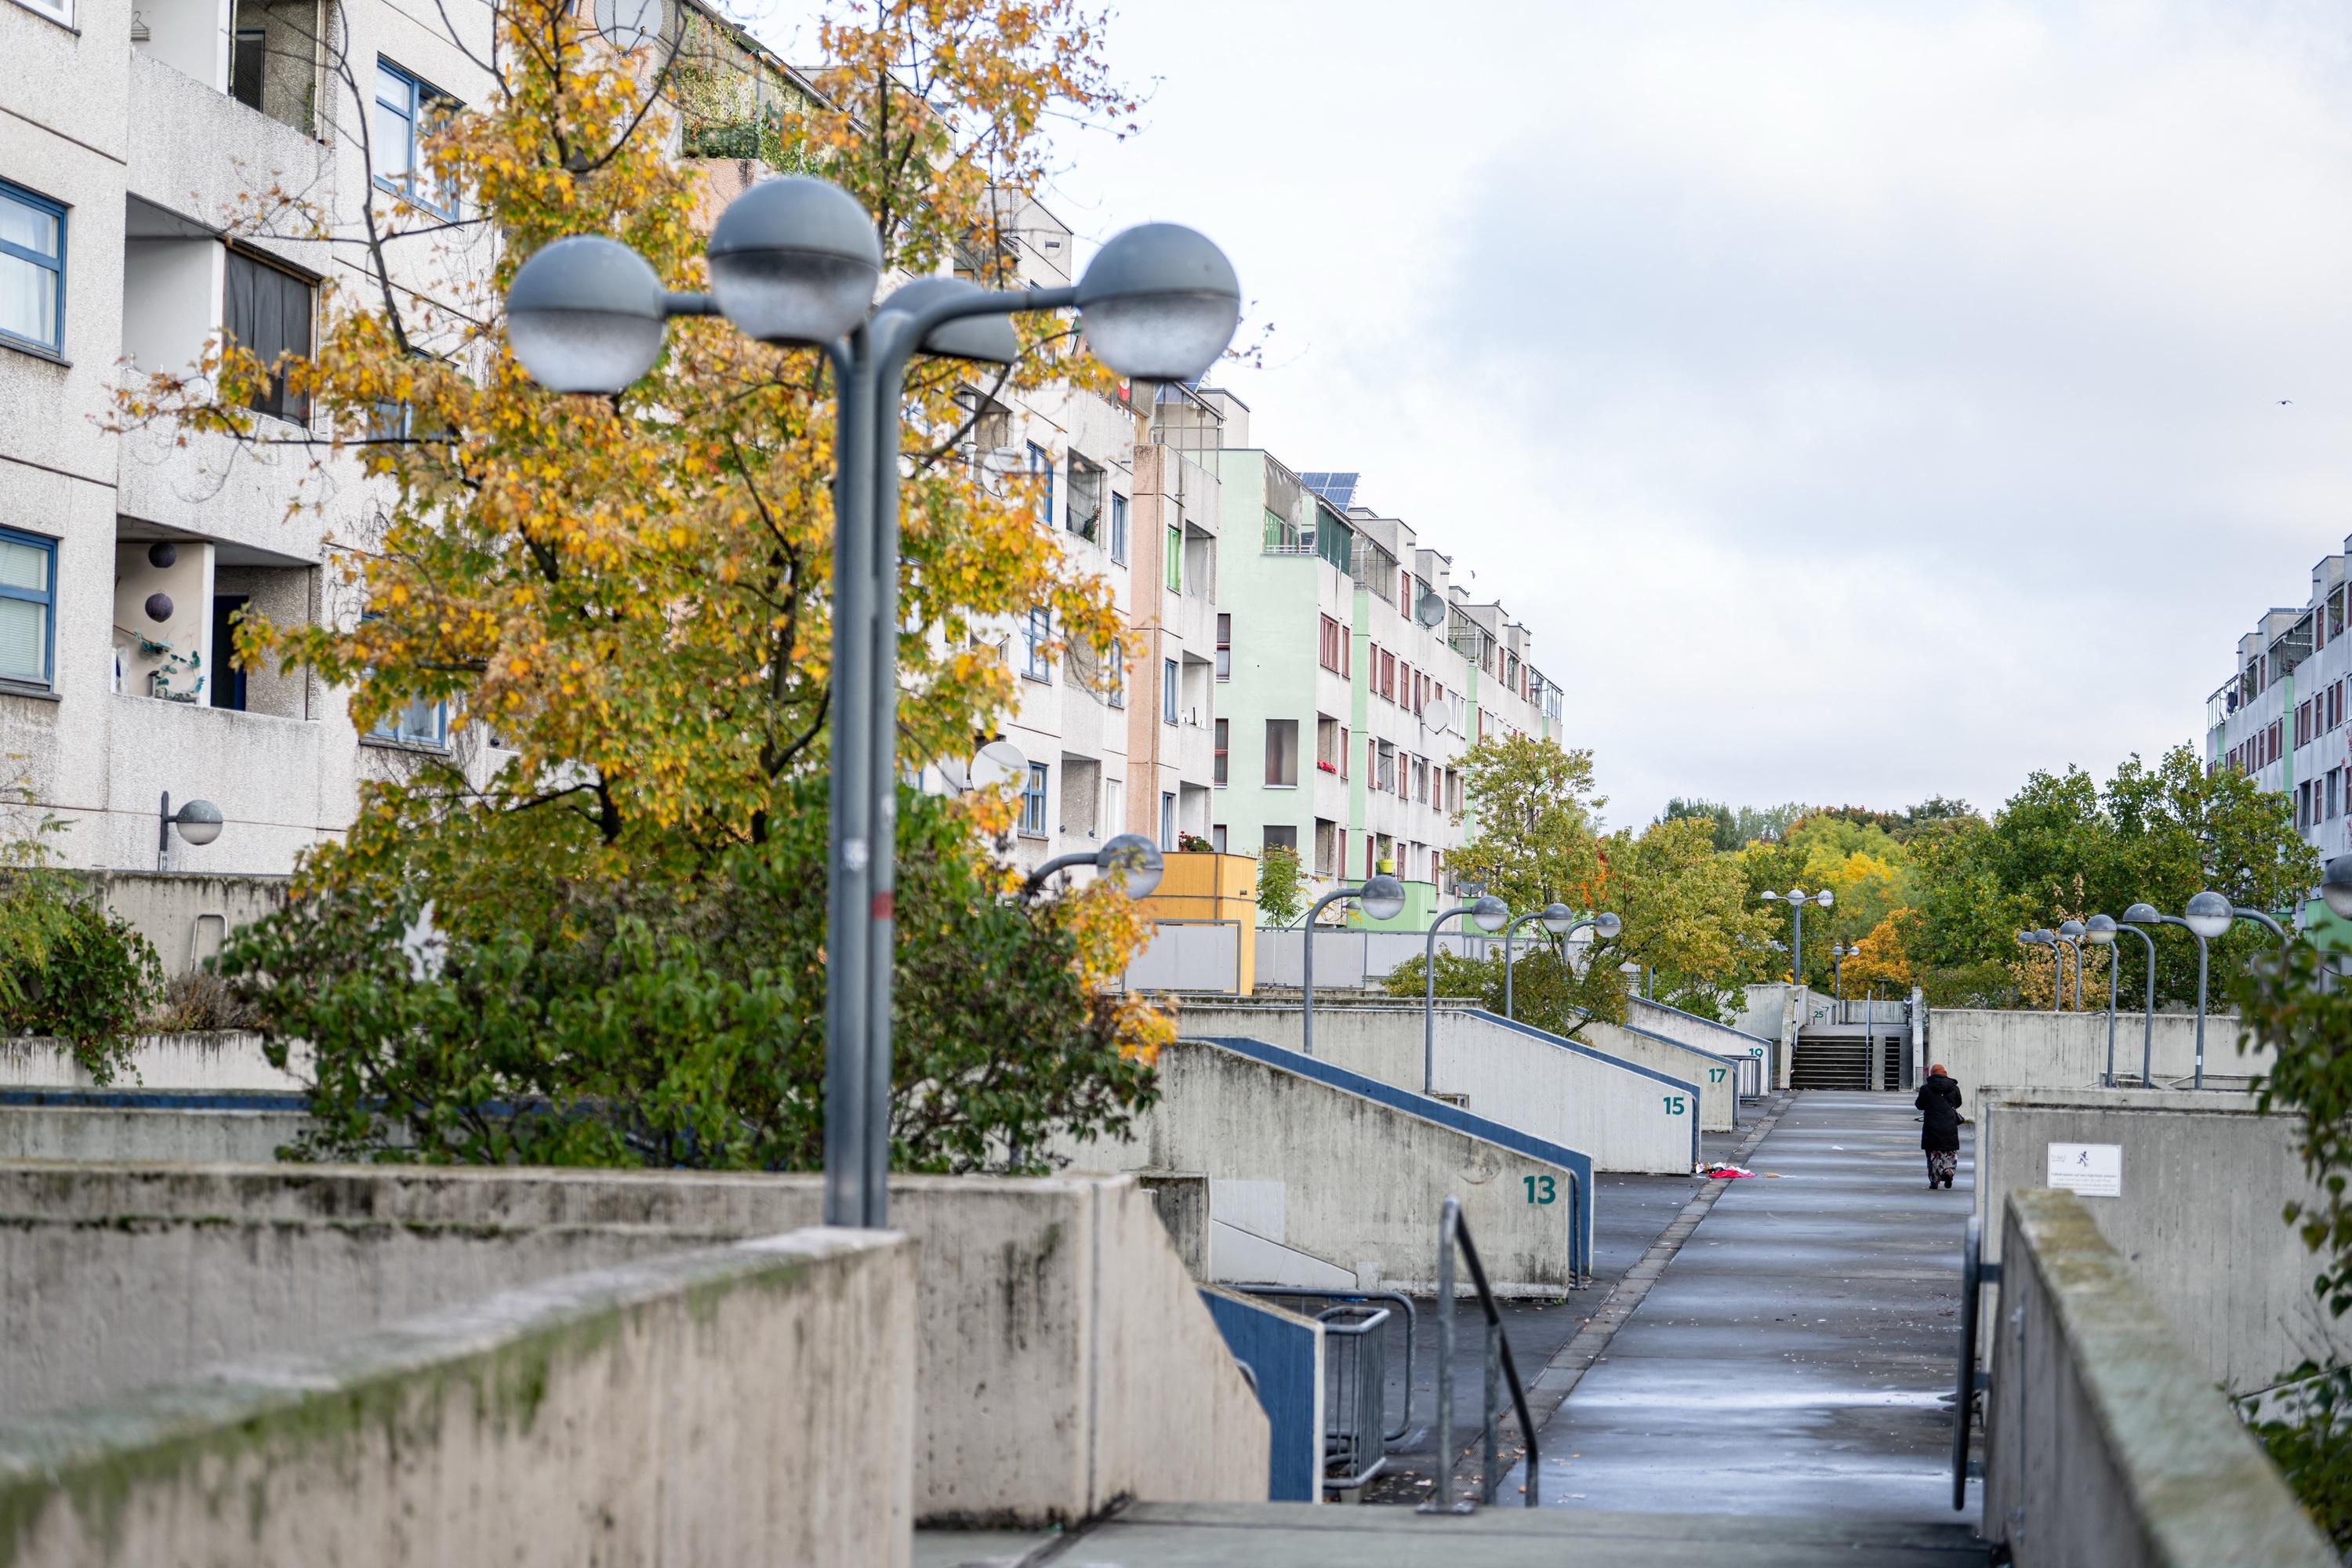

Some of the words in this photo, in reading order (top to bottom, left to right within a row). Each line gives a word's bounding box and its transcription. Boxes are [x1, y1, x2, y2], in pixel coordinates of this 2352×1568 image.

[1748, 1048, 1763, 1058] 19
[1709, 1068, 1726, 1083] 17
[1663, 1097, 1685, 1115] 15
[1523, 1176, 1556, 1204] 13
